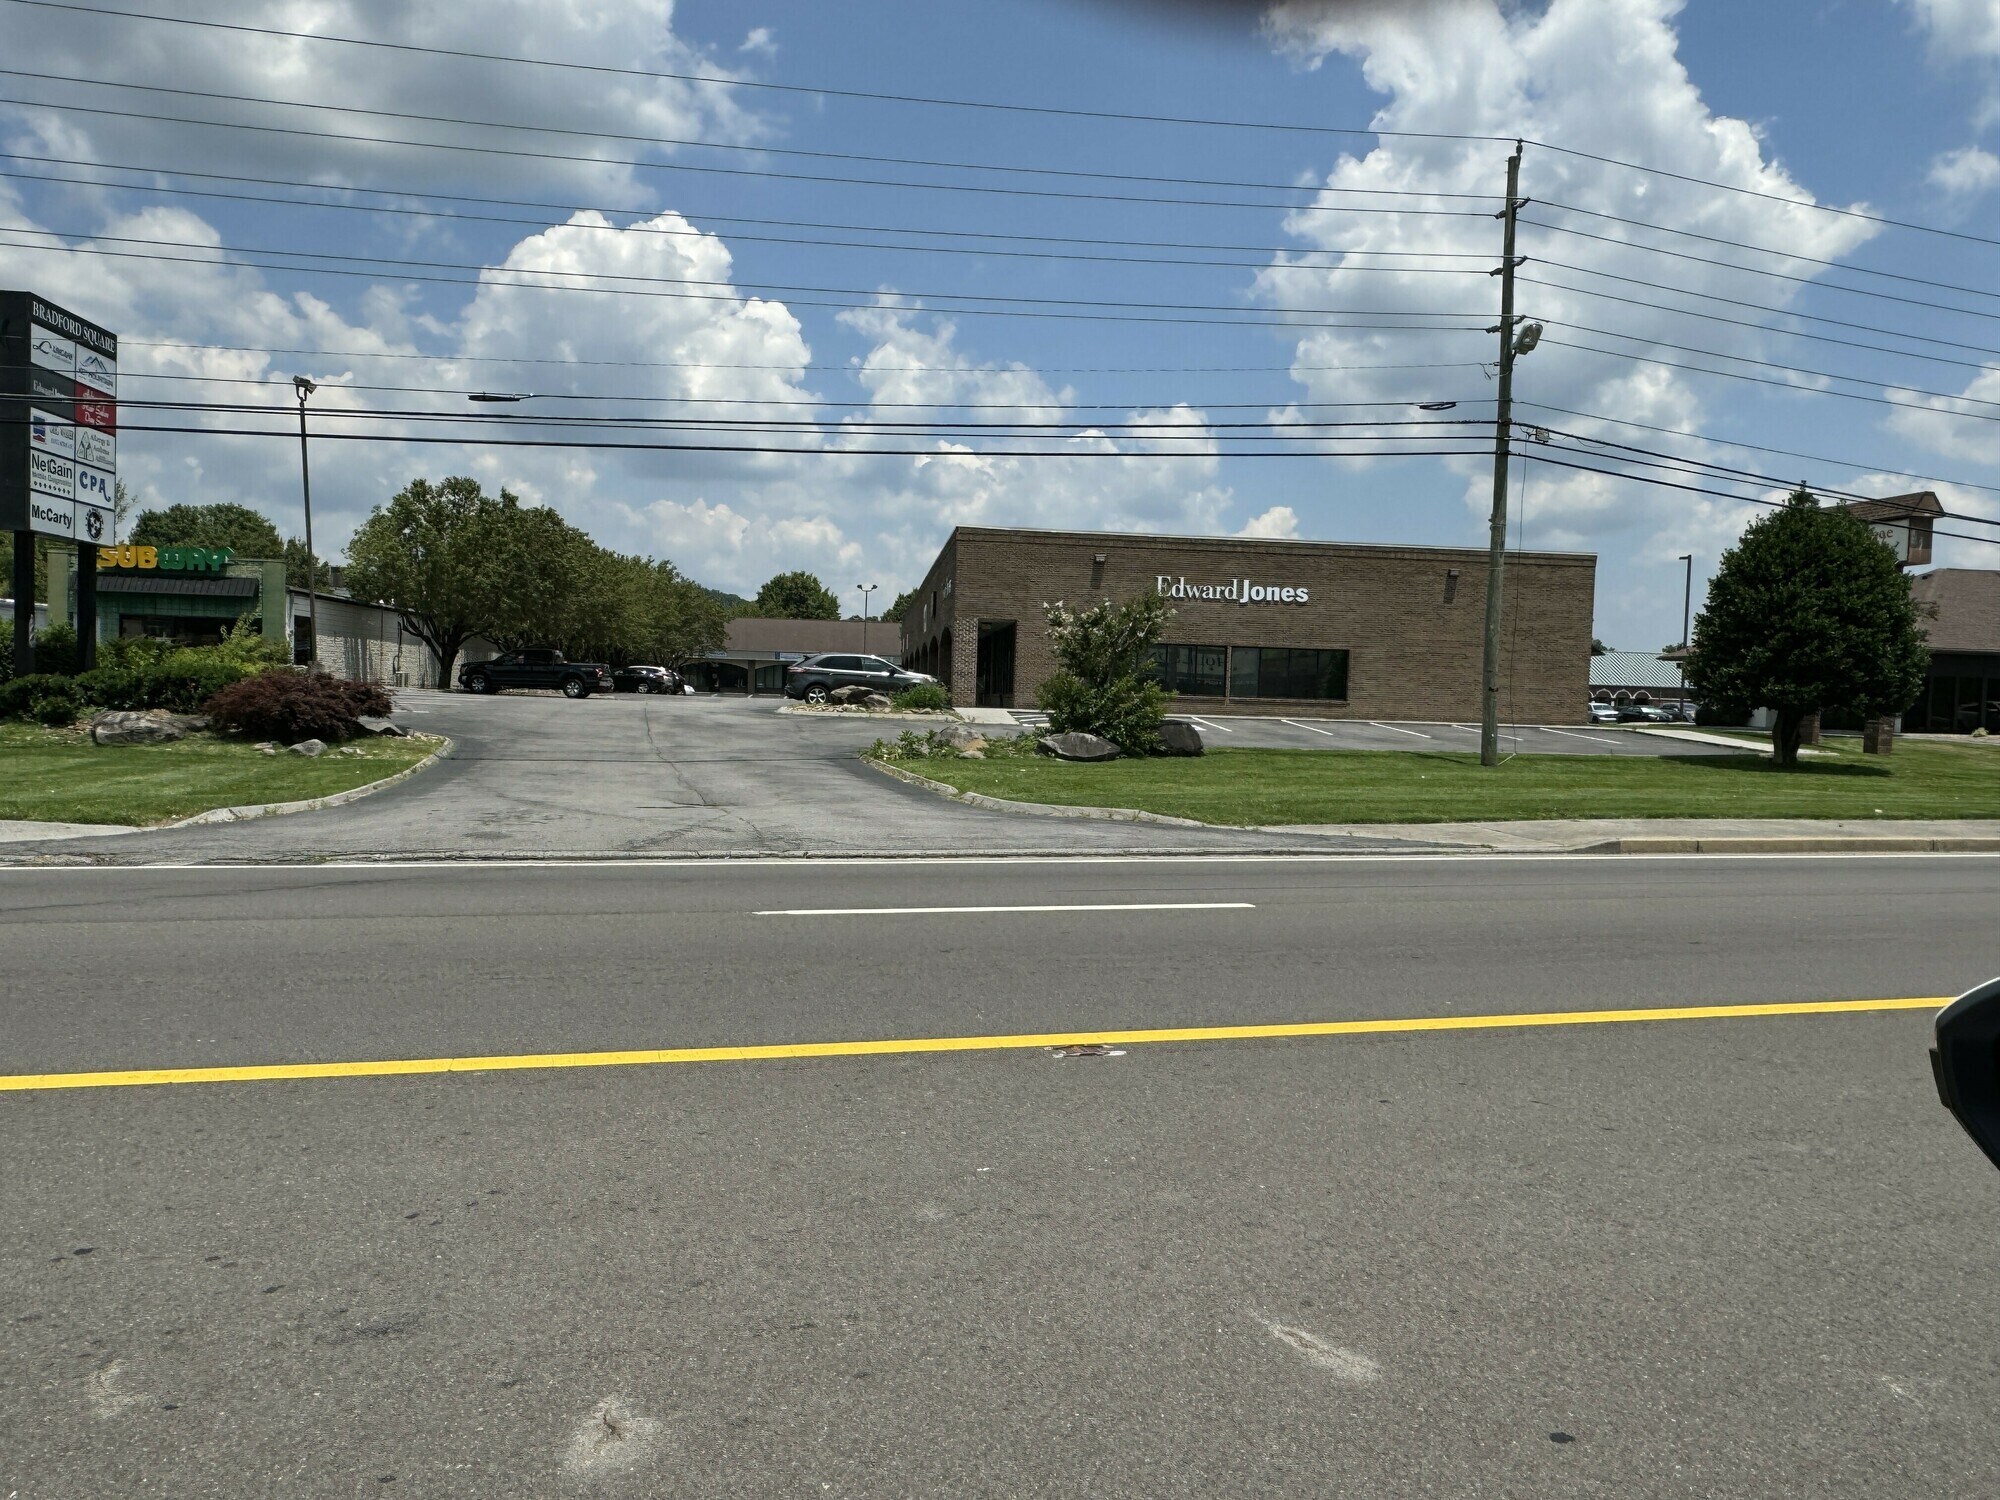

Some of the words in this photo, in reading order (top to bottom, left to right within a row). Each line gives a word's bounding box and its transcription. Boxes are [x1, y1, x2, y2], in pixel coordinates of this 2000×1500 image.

[33, 300, 82, 337] BRADFORD
[82, 327, 116, 354] SQUARE
[32, 453, 72, 480] NetGain
[80, 470, 111, 503] CPA
[32, 504, 72, 529] McCarty
[97, 545, 234, 571] SUBWAY
[1156, 576, 1239, 599] Edward
[1239, 579, 1309, 603] Jones
